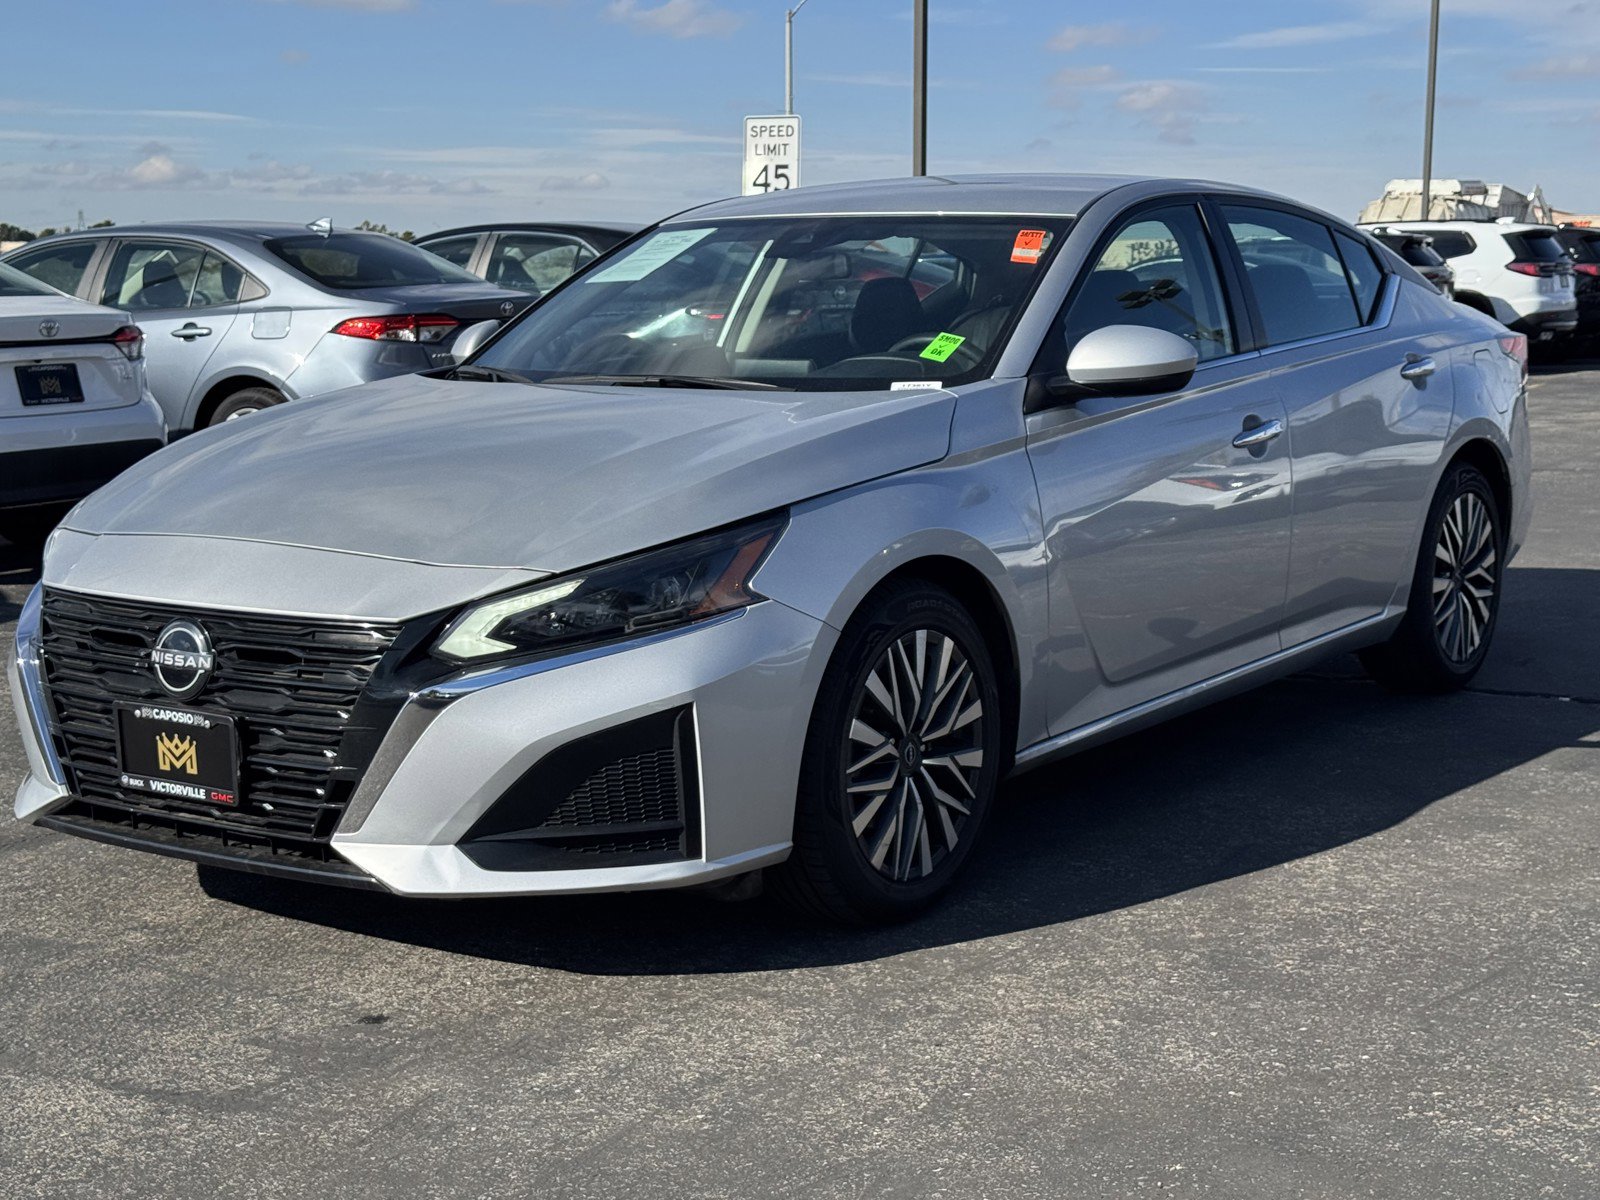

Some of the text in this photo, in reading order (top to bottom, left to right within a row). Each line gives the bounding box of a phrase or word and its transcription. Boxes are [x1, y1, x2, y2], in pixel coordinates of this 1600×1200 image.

[750, 125, 795, 137] SPEED
[754, 143, 789, 156] LIMIT
[752, 164, 790, 193] 45
[939, 335, 960, 345] SMOG
[930, 348, 945, 356] OK
[151, 650, 211, 669] NISSAN
[153, 708, 194, 725] CAPOSIO
[149, 779, 206, 799] VICTORVILLE
[210, 791, 233, 803] GMC
